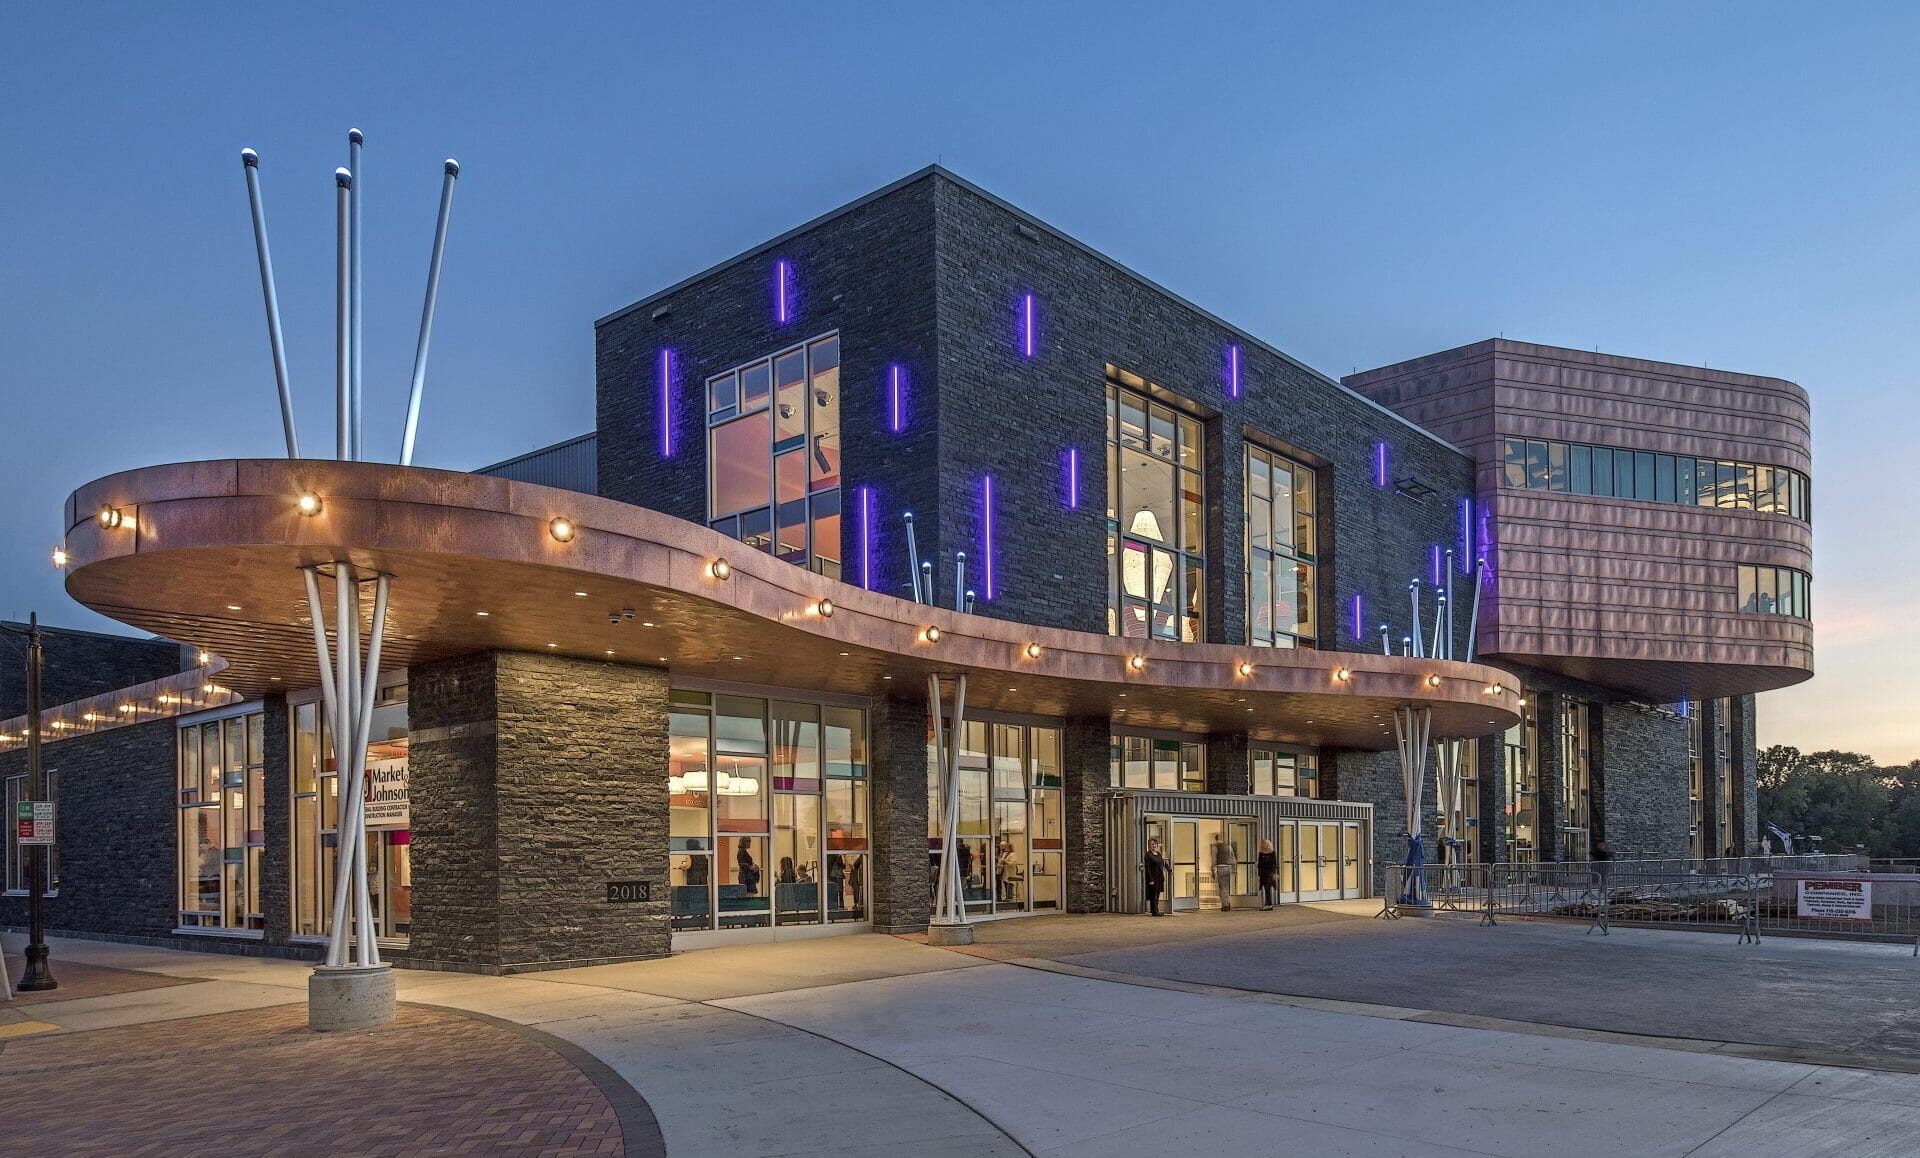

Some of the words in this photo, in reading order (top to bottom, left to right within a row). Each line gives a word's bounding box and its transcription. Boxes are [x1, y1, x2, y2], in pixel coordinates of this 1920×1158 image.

[373, 765, 404, 783] Market
[373, 785, 409, 802] Johnson
[610, 885, 647, 900] 2018
[1805, 881, 1863, 892] PEMBER
